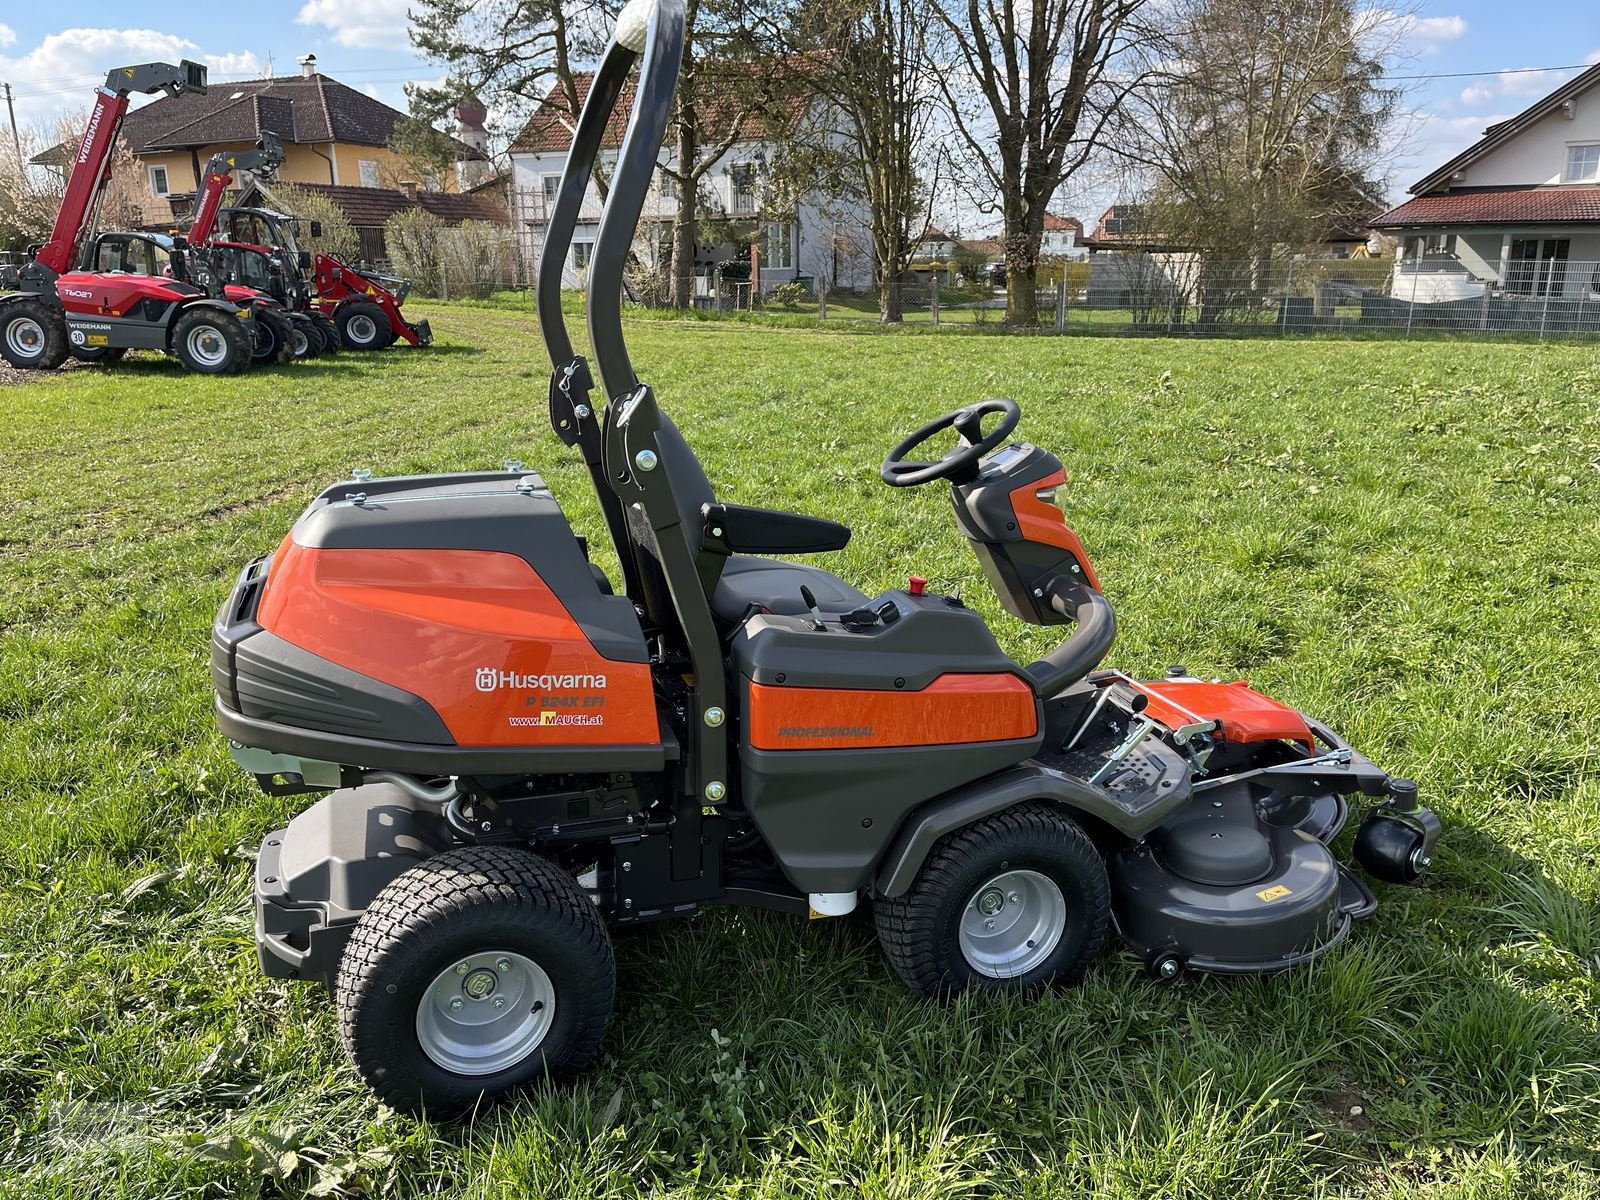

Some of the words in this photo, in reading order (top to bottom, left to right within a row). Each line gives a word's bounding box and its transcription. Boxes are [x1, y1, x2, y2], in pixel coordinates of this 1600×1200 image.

[78, 103, 105, 163] WEIDEMANN
[69, 322, 112, 330] WEIDEMANN
[72, 333, 83, 342] 30
[499, 671, 607, 691] Husqvarna
[526, 696, 537, 707] P
[582, 695, 606, 707] EFI
[778, 727, 875, 737] PROFESSIONAL
